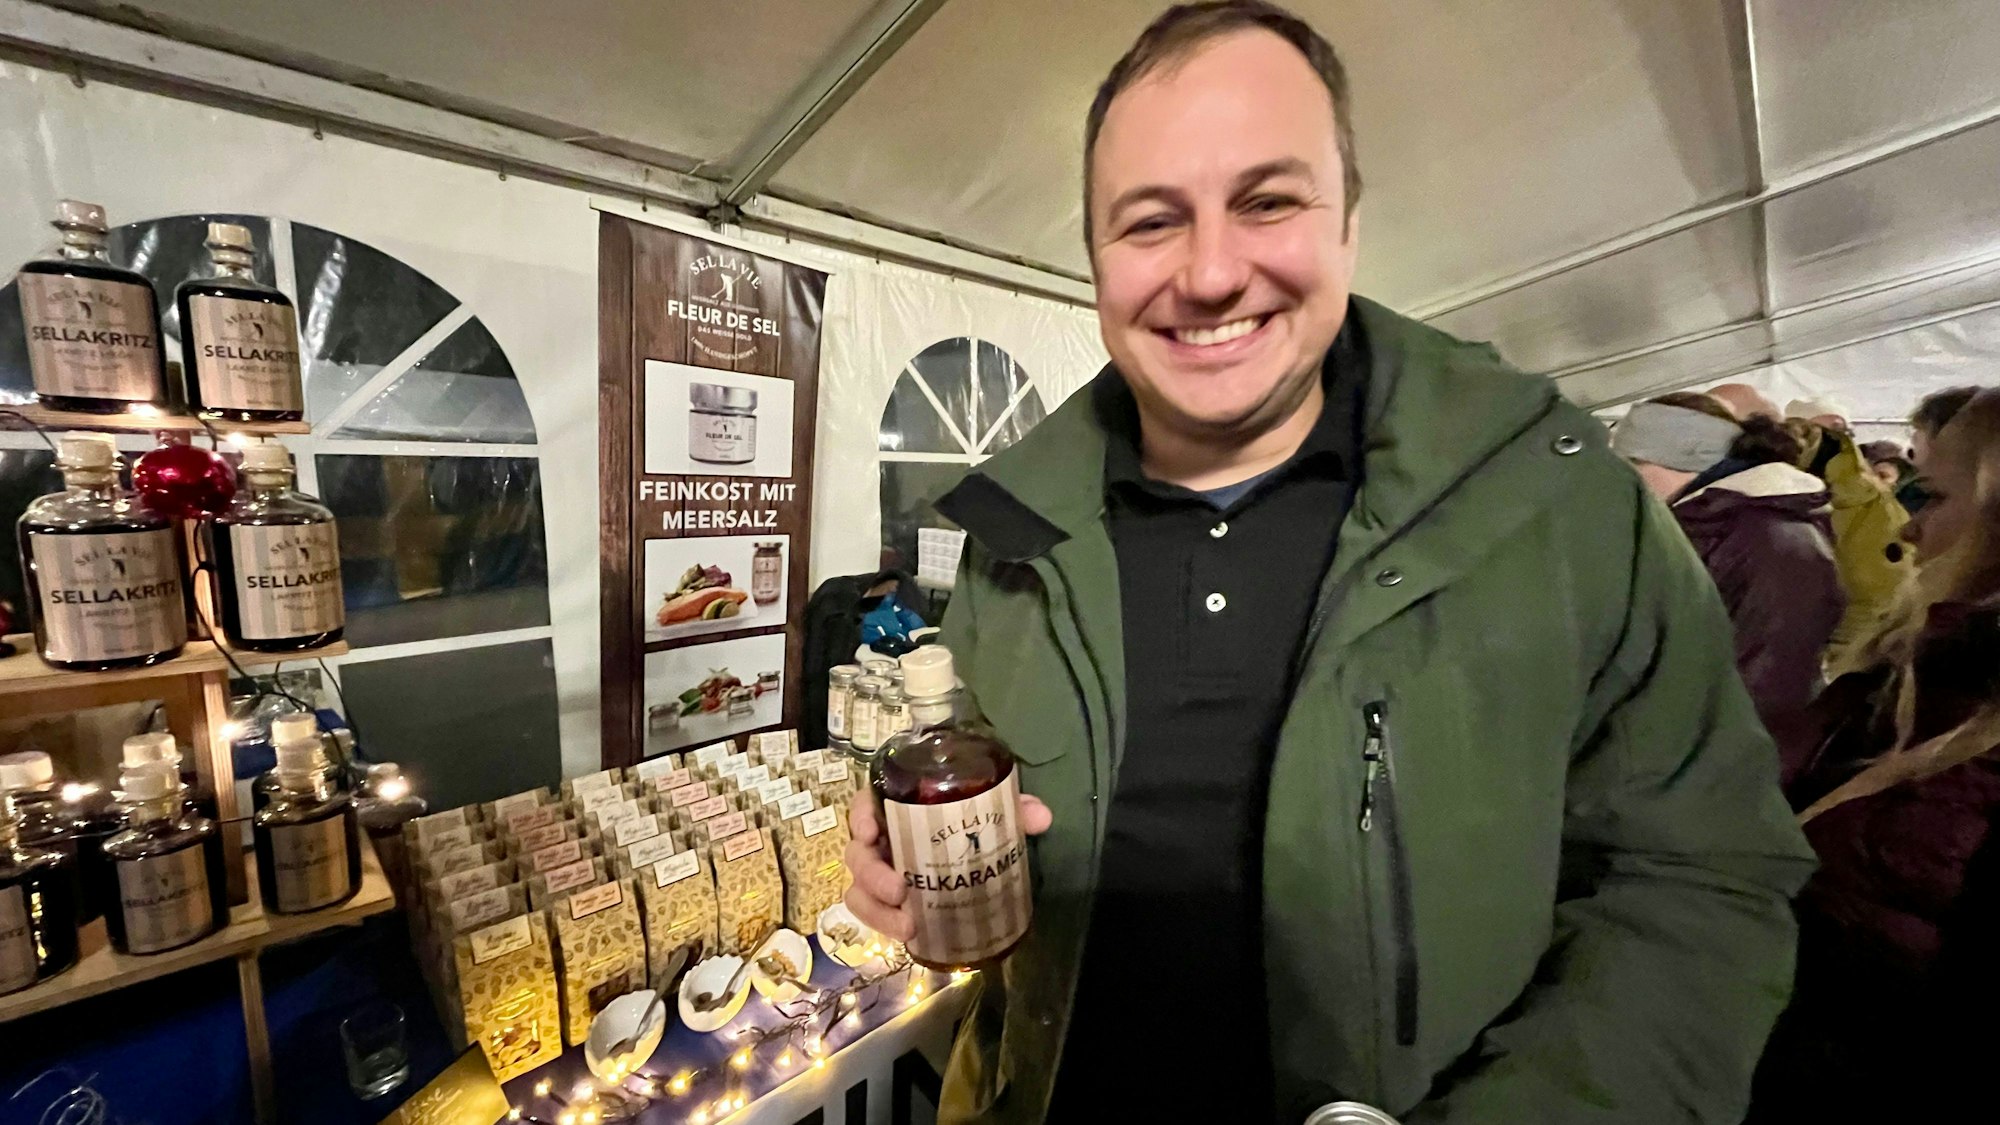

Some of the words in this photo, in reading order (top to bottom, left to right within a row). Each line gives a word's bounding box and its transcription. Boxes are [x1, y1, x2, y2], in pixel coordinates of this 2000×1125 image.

[690, 255, 717, 275] SEL
[719, 254, 737, 271] LA
[740, 263, 762, 290] VIE
[667, 299, 722, 326] FLEUR
[726, 311, 748, 331] DE
[752, 317, 781, 337] SEL
[32, 325, 154, 349] SELLAKRITZ
[639, 481, 754, 502] FEINKOST
[760, 483, 797, 501] MIT
[662, 510, 778, 530] MEERSALZ
[930, 825, 959, 846] SEL
[961, 815, 981, 829] LA
